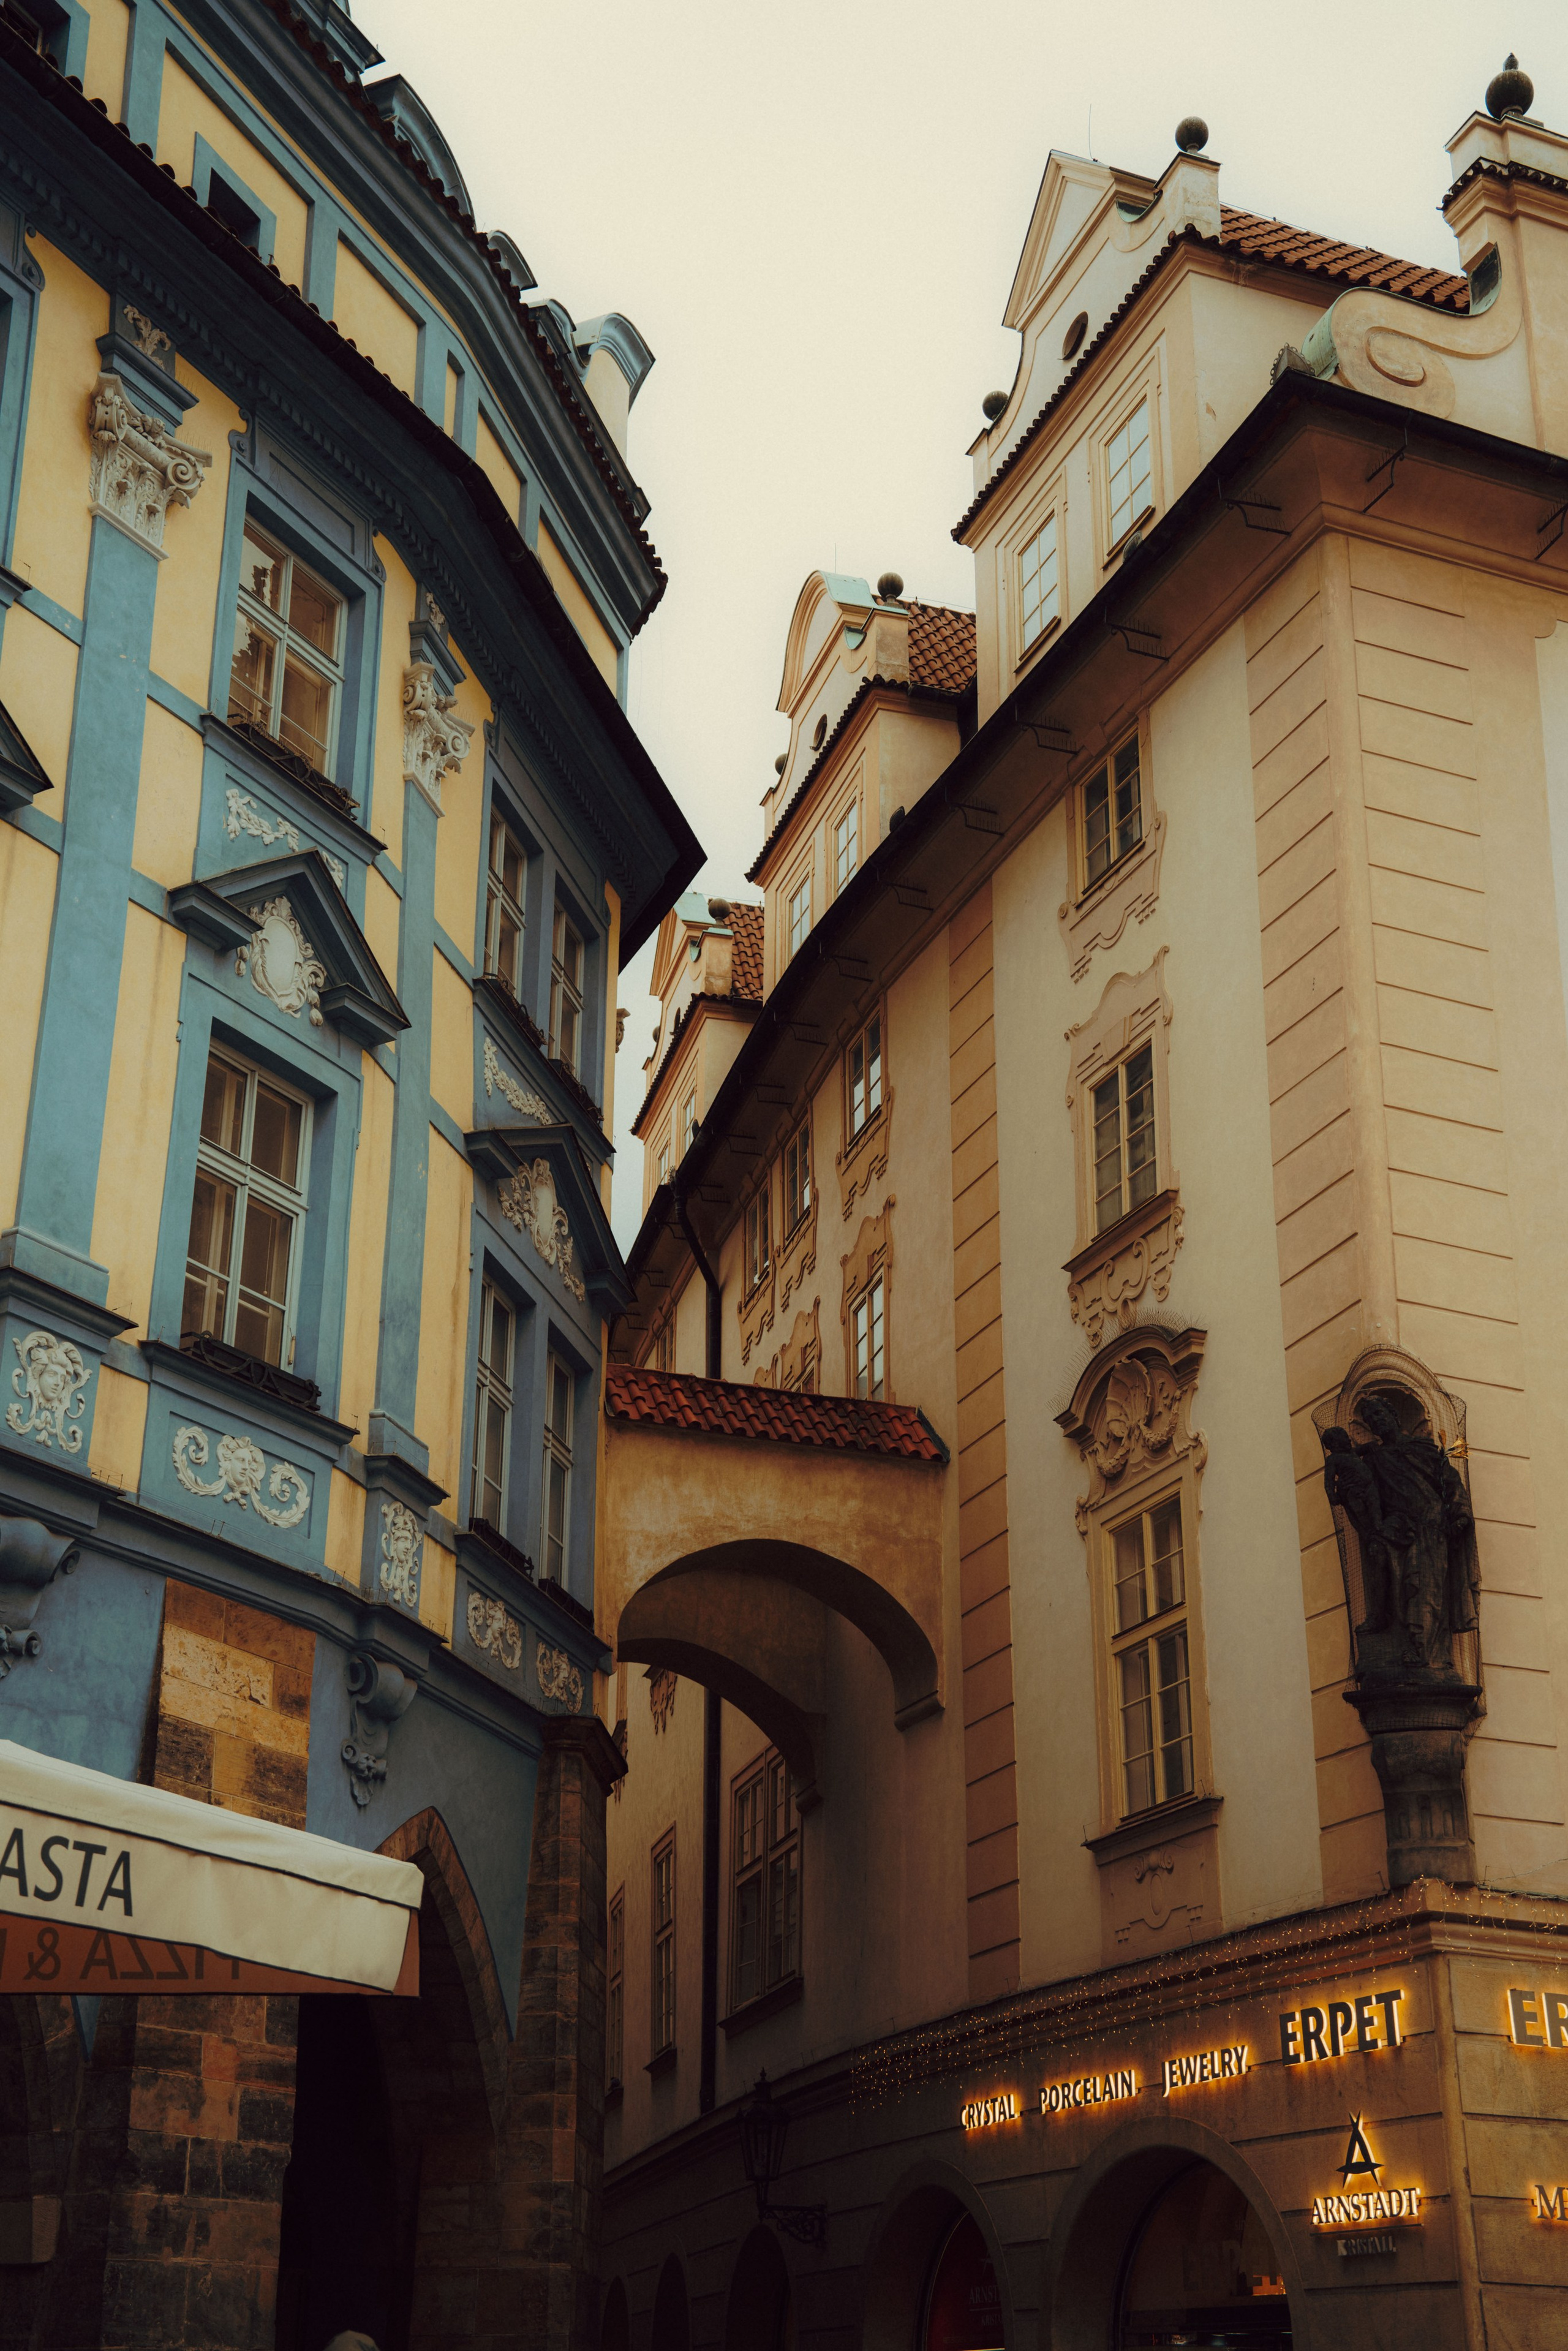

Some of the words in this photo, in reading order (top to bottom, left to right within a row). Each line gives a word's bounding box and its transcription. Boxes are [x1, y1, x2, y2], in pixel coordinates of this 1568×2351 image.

[1280, 1989, 1405, 2066] ERPET
[960, 2094, 1017, 2130] CRYSTAL
[1038, 2069, 1135, 2115] PORCELAIN
[1161, 2045, 1248, 2097] JEWELRY
[1310, 2187, 1421, 2225] ARNSTADT
[969, 2285, 1001, 2304] ARNST
